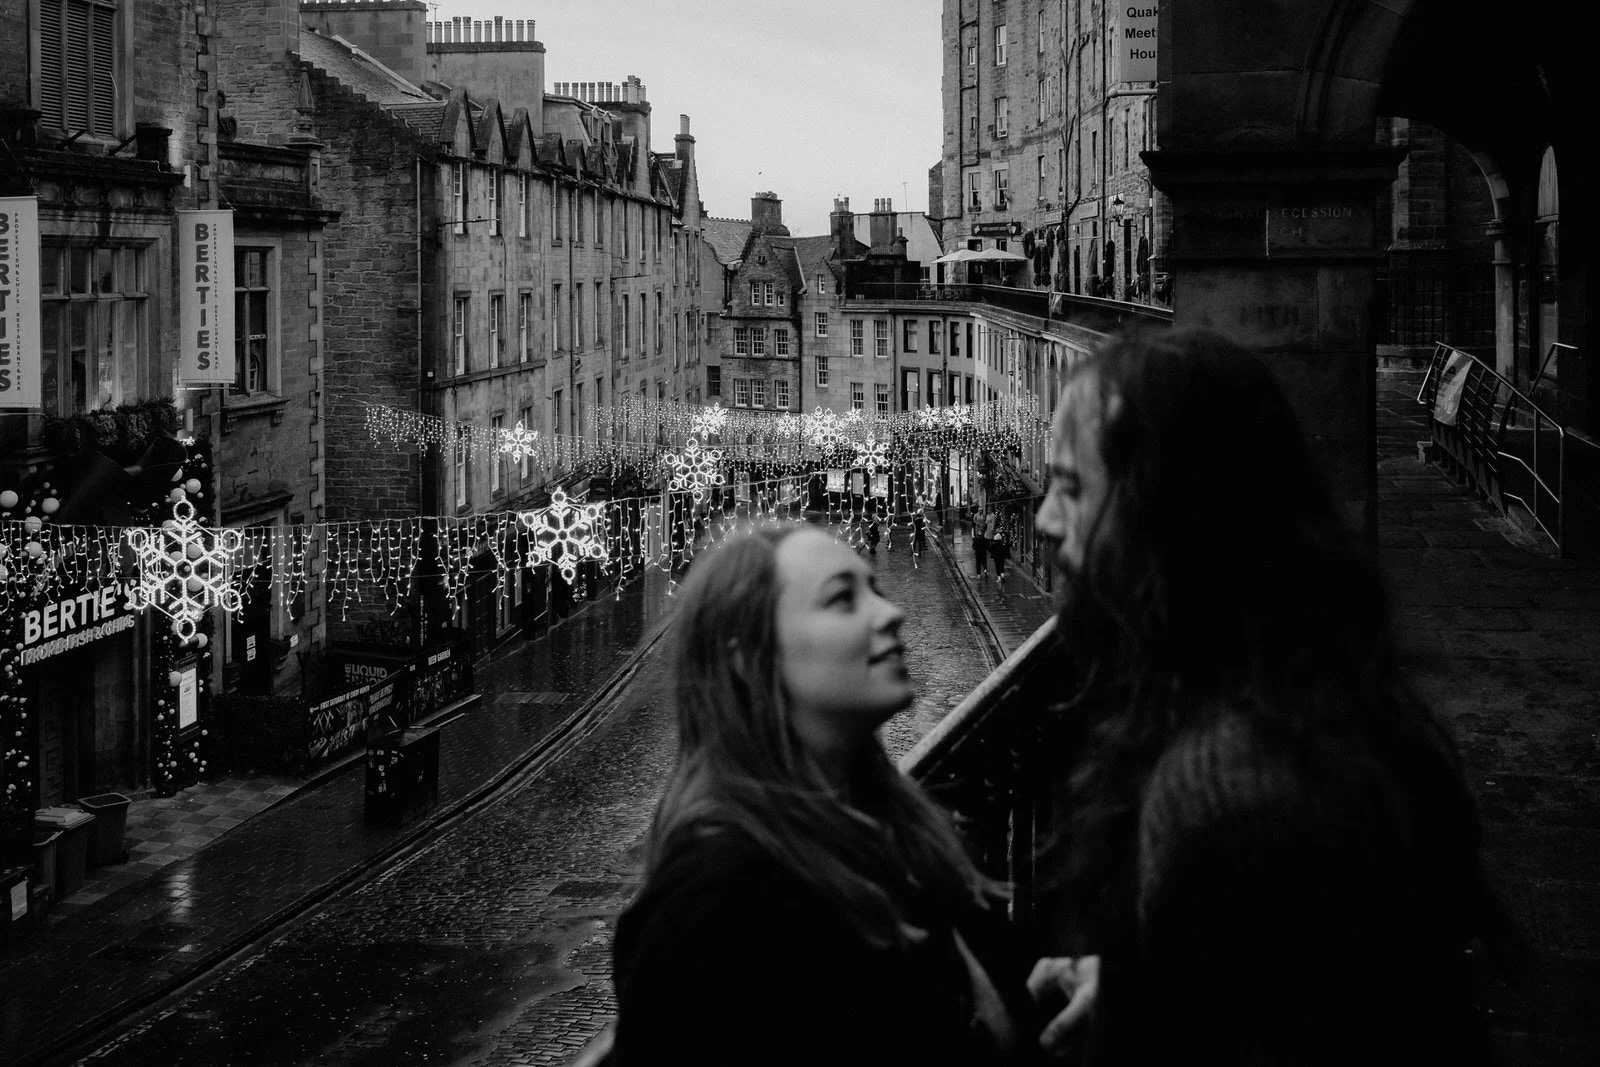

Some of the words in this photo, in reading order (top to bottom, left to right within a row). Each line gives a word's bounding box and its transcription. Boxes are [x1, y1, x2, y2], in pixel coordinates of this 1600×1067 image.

[194, 223, 211, 371] BERTIES
[24, 578, 139, 646] BERTIE'S
[102, 613, 136, 636] CHIPS
[351, 663, 388, 679] LIQUID
